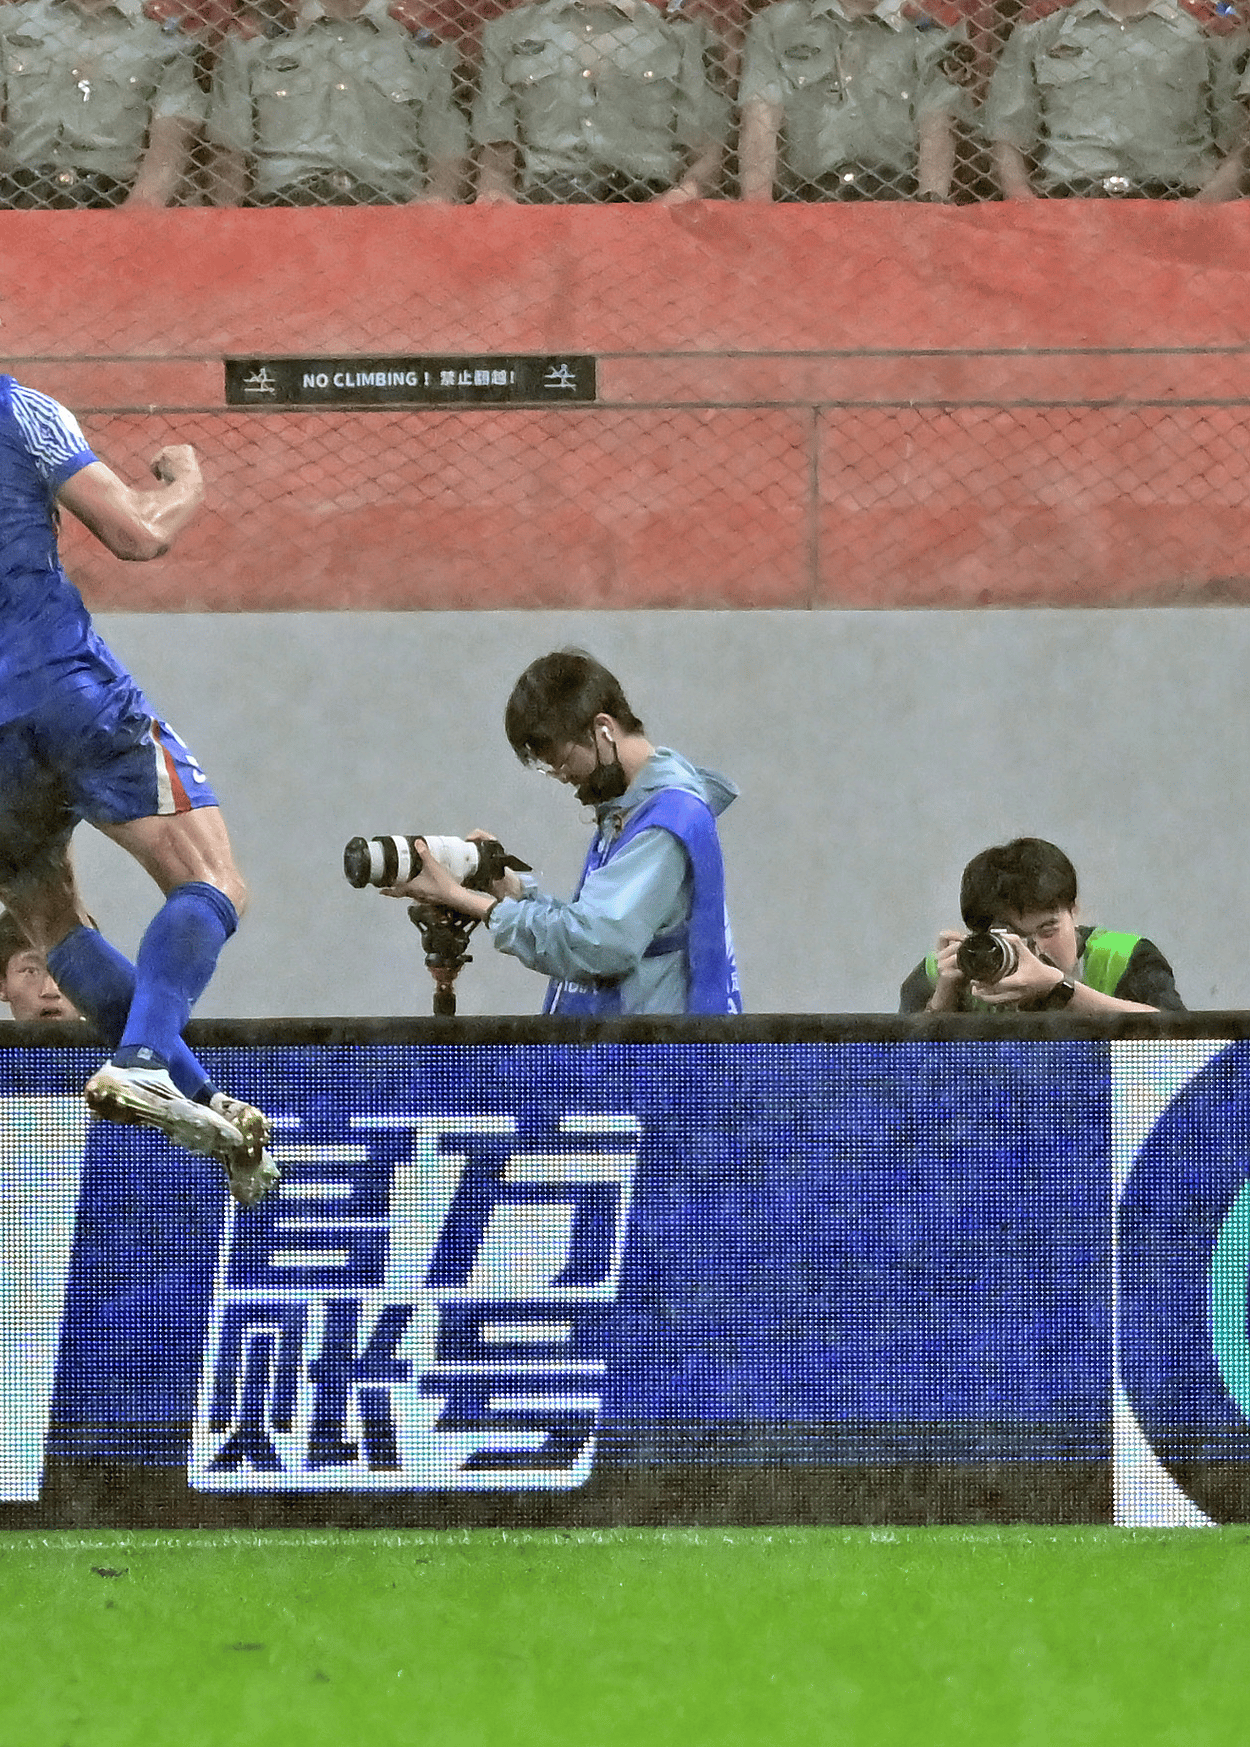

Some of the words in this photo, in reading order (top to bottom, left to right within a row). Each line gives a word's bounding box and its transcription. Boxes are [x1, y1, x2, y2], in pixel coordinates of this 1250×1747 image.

[302, 373, 329, 388] NO
[333, 371, 418, 387] CLIMBING
[190, 1300, 610, 1482] 账号
